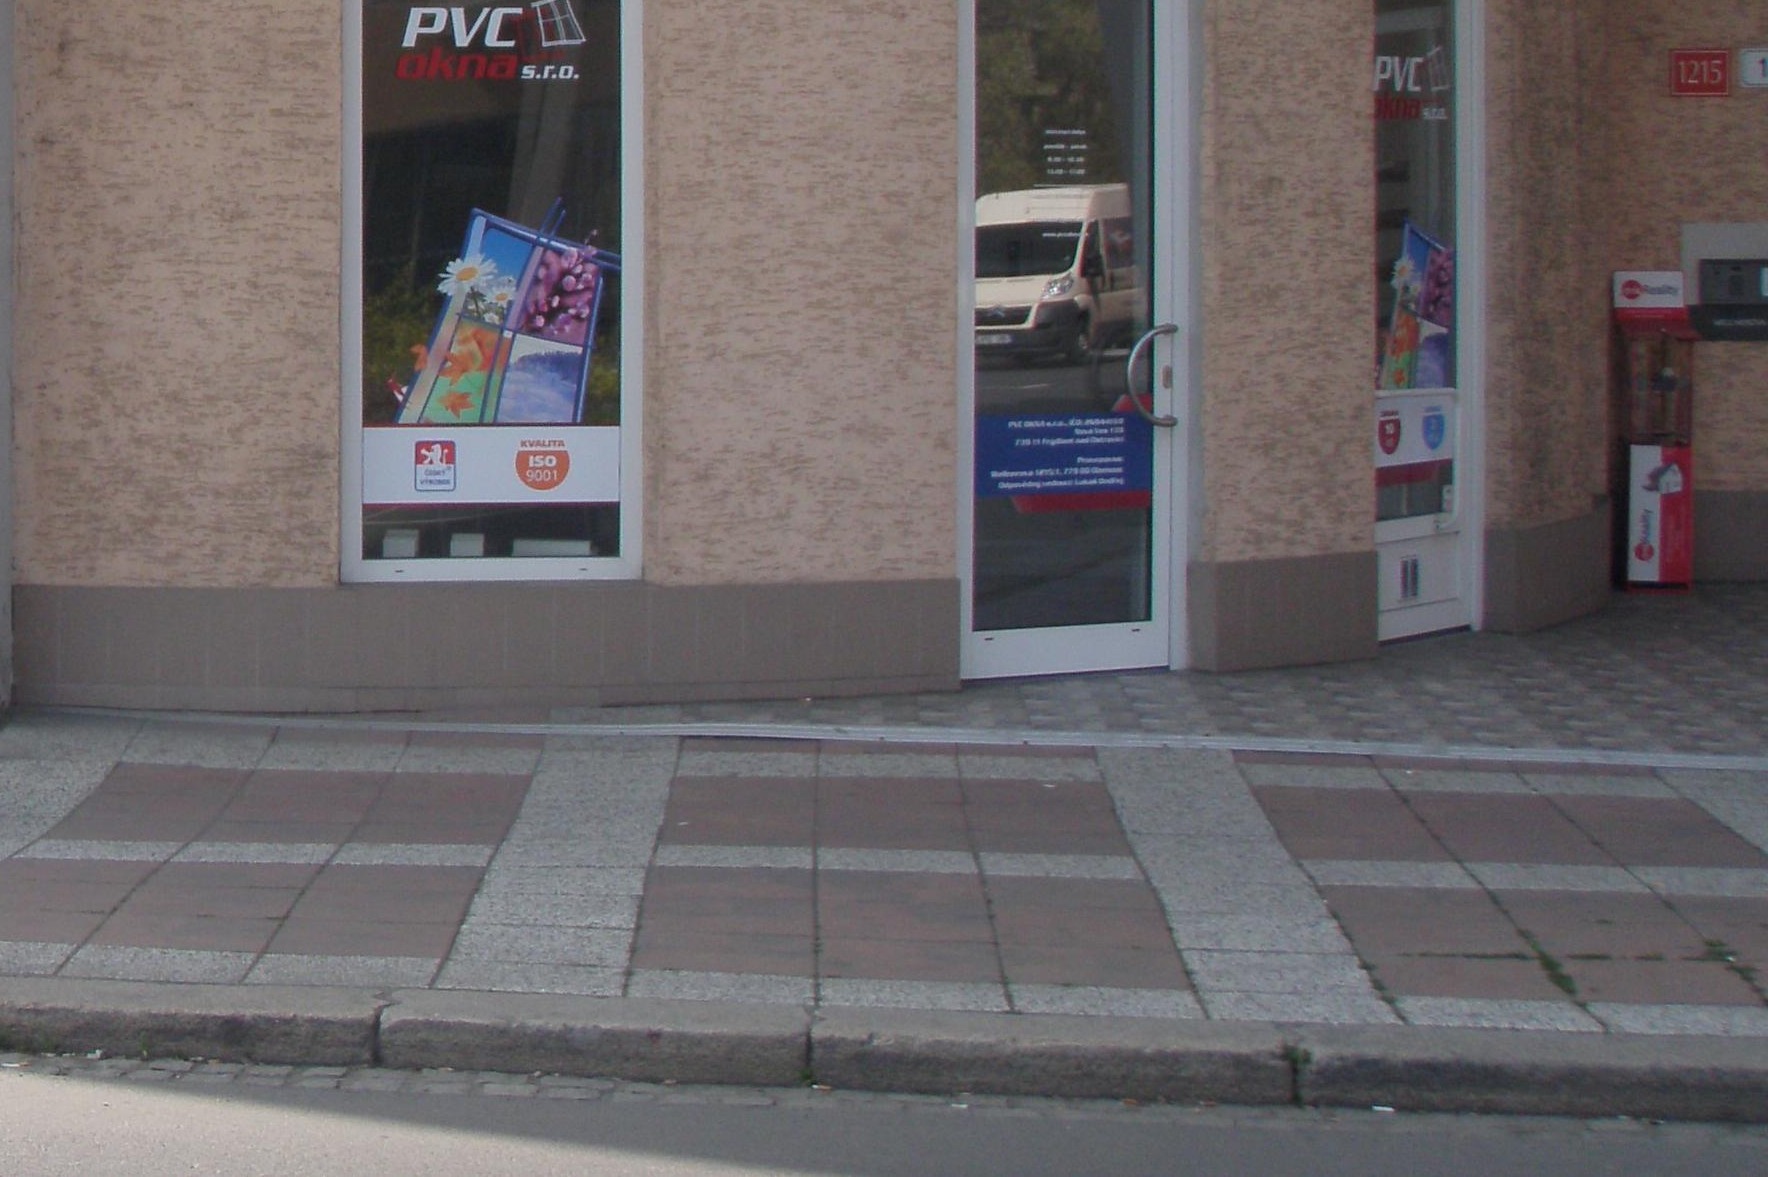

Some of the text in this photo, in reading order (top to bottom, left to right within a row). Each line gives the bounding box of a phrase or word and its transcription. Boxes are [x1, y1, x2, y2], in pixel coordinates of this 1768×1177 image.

[401, 7, 523, 47] PVC
[395, 47, 580, 80] okna s.r.o.
[1372, 55, 1425, 92] PVC
[1678, 60, 1722, 84] 1215
[520, 439, 566, 448] KVALITA
[529, 454, 557, 468] ISO
[526, 469, 558, 482] 9001
